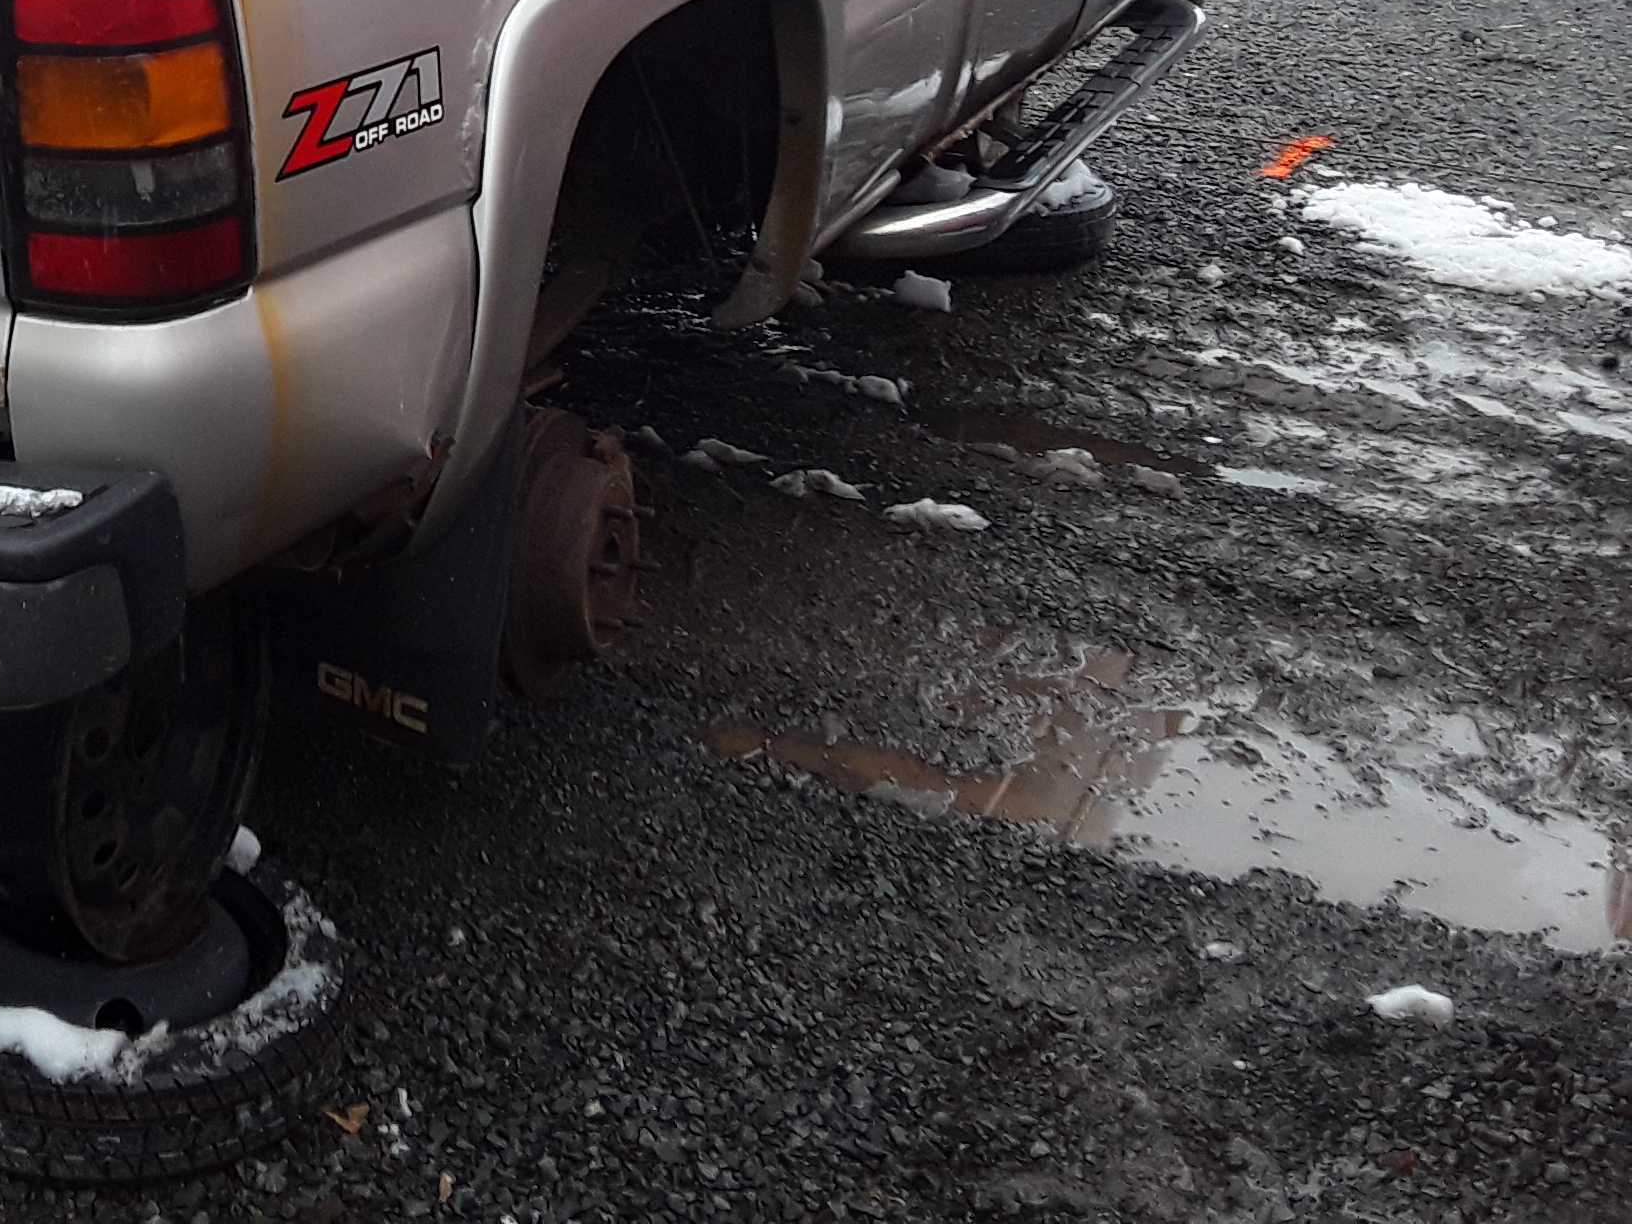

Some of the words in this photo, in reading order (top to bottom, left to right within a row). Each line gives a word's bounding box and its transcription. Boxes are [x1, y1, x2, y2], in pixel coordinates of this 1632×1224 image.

[275, 45, 443, 183] Z71
[354, 123, 389, 150] OFF
[395, 104, 443, 135] ROAD
[319, 662, 429, 734] GMC
